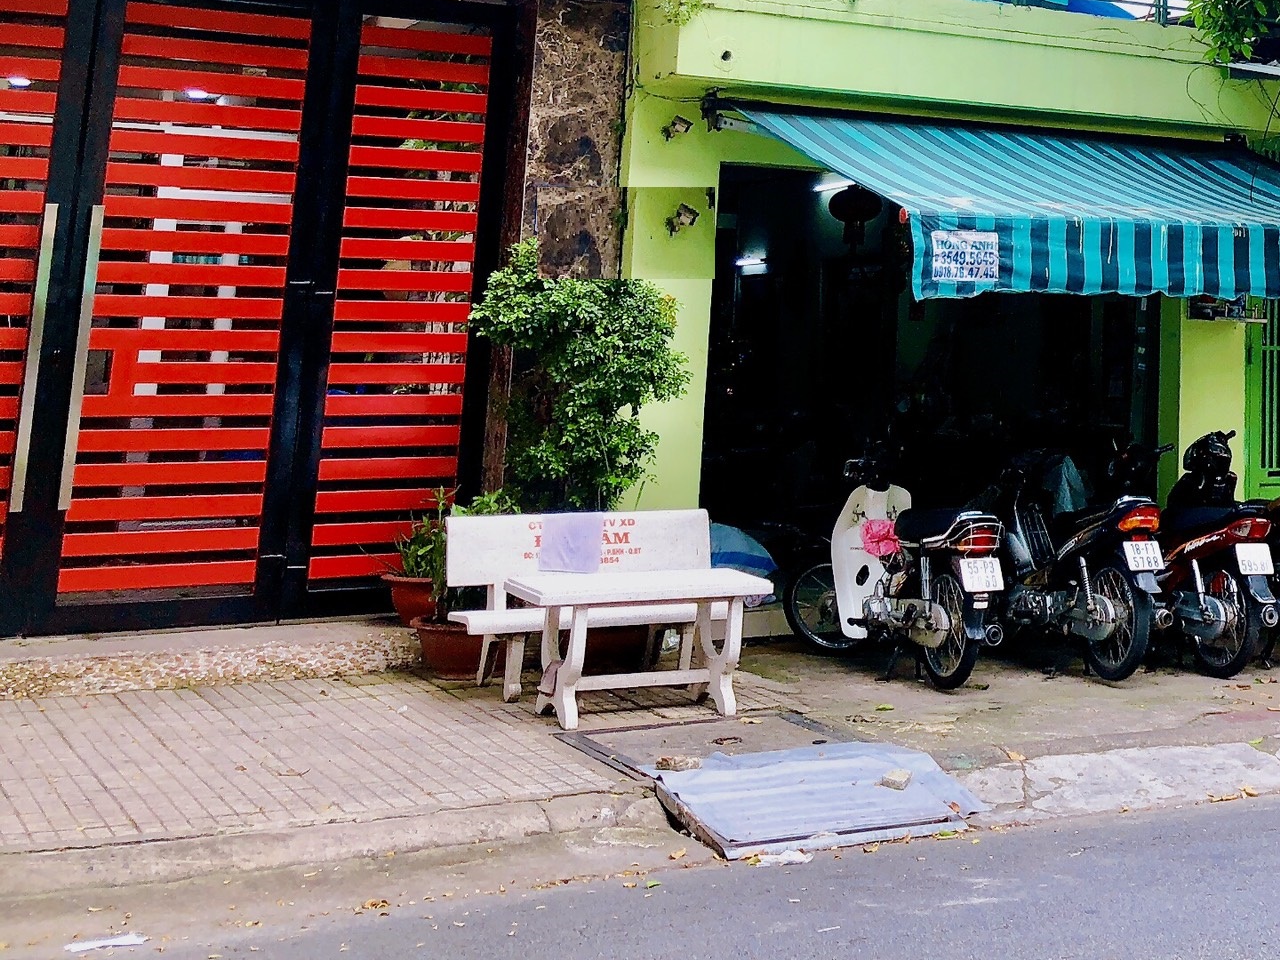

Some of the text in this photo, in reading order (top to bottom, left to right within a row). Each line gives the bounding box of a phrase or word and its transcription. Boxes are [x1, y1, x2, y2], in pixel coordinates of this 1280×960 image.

[971, 240, 994, 251] ANH
[619, 518, 636, 527] XD
[1130, 543, 1156, 556] 18-F1
[967, 560, 995, 575] 55-P3
[1132, 555, 1160, 569] 5788
